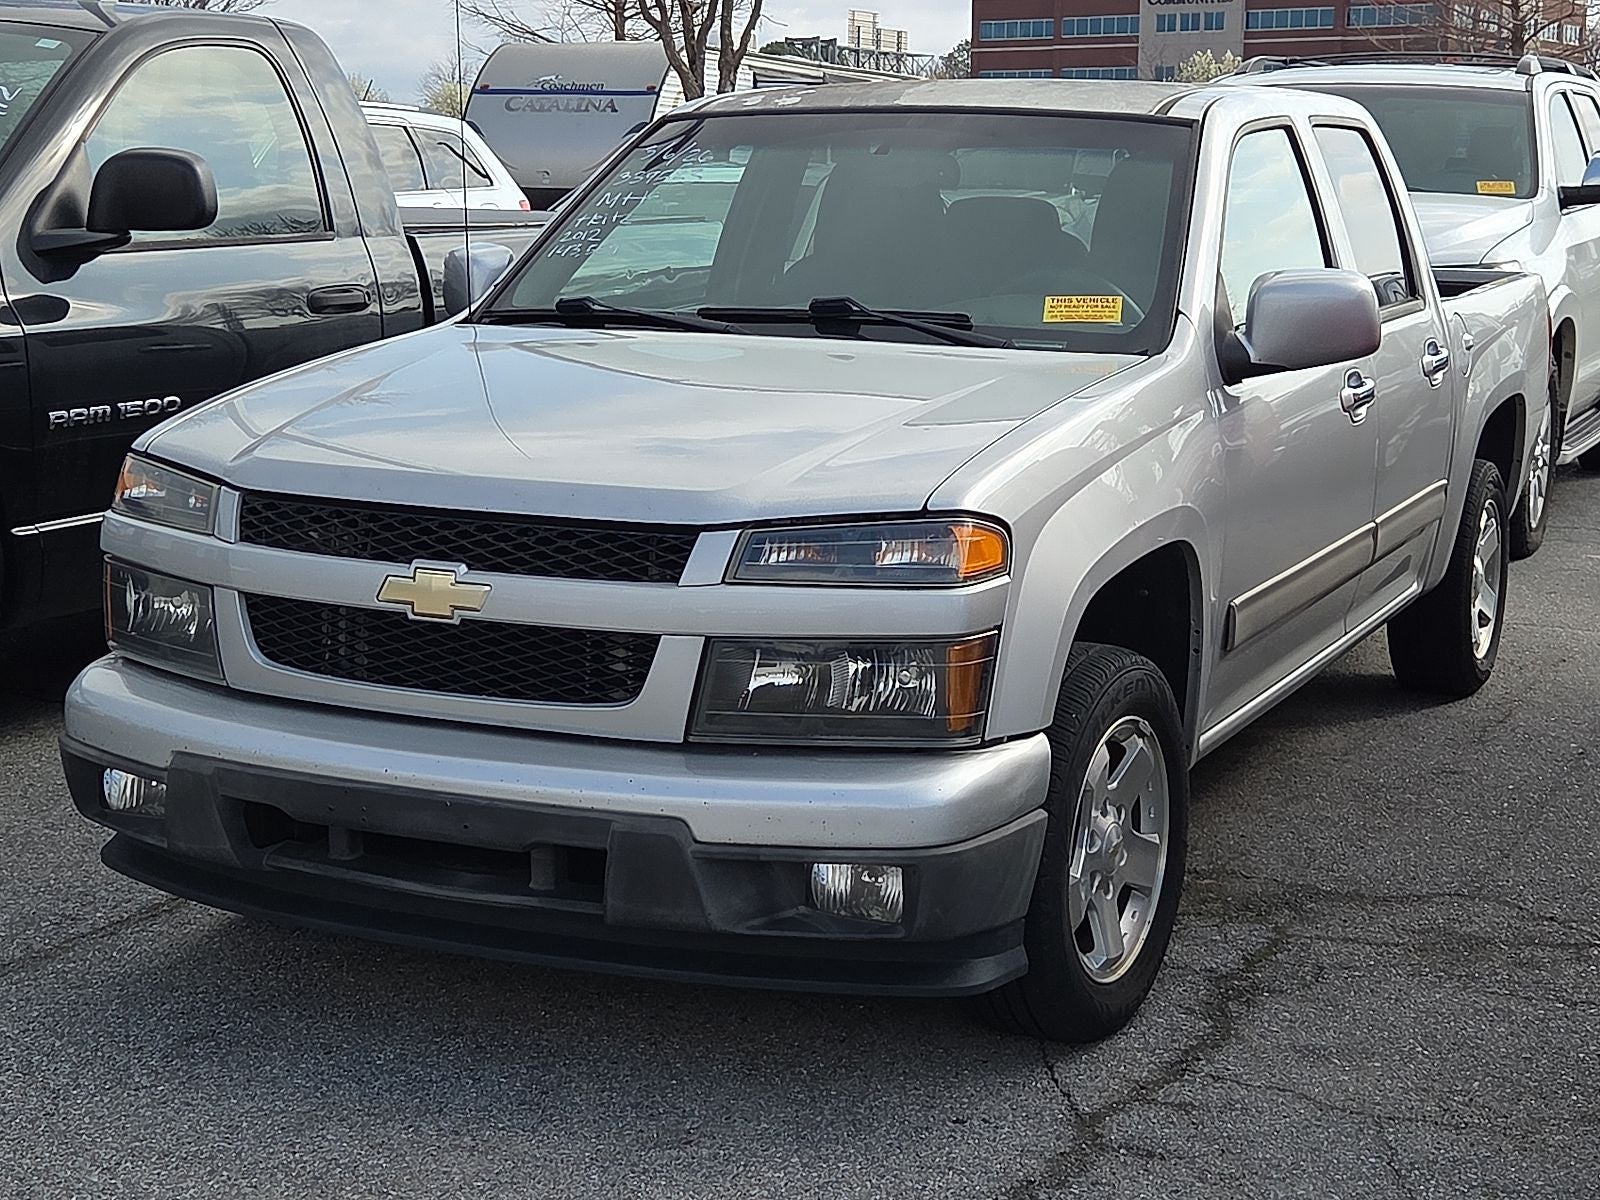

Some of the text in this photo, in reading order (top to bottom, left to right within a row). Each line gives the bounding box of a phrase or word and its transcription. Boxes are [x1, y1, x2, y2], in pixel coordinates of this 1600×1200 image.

[540, 81, 605, 92] Coachmen
[504, 96, 619, 113] CATALINA
[559, 228, 602, 243] 2012
[1075, 297, 1118, 305] VEHICLE
[48, 395, 181, 430] RAM 1500
